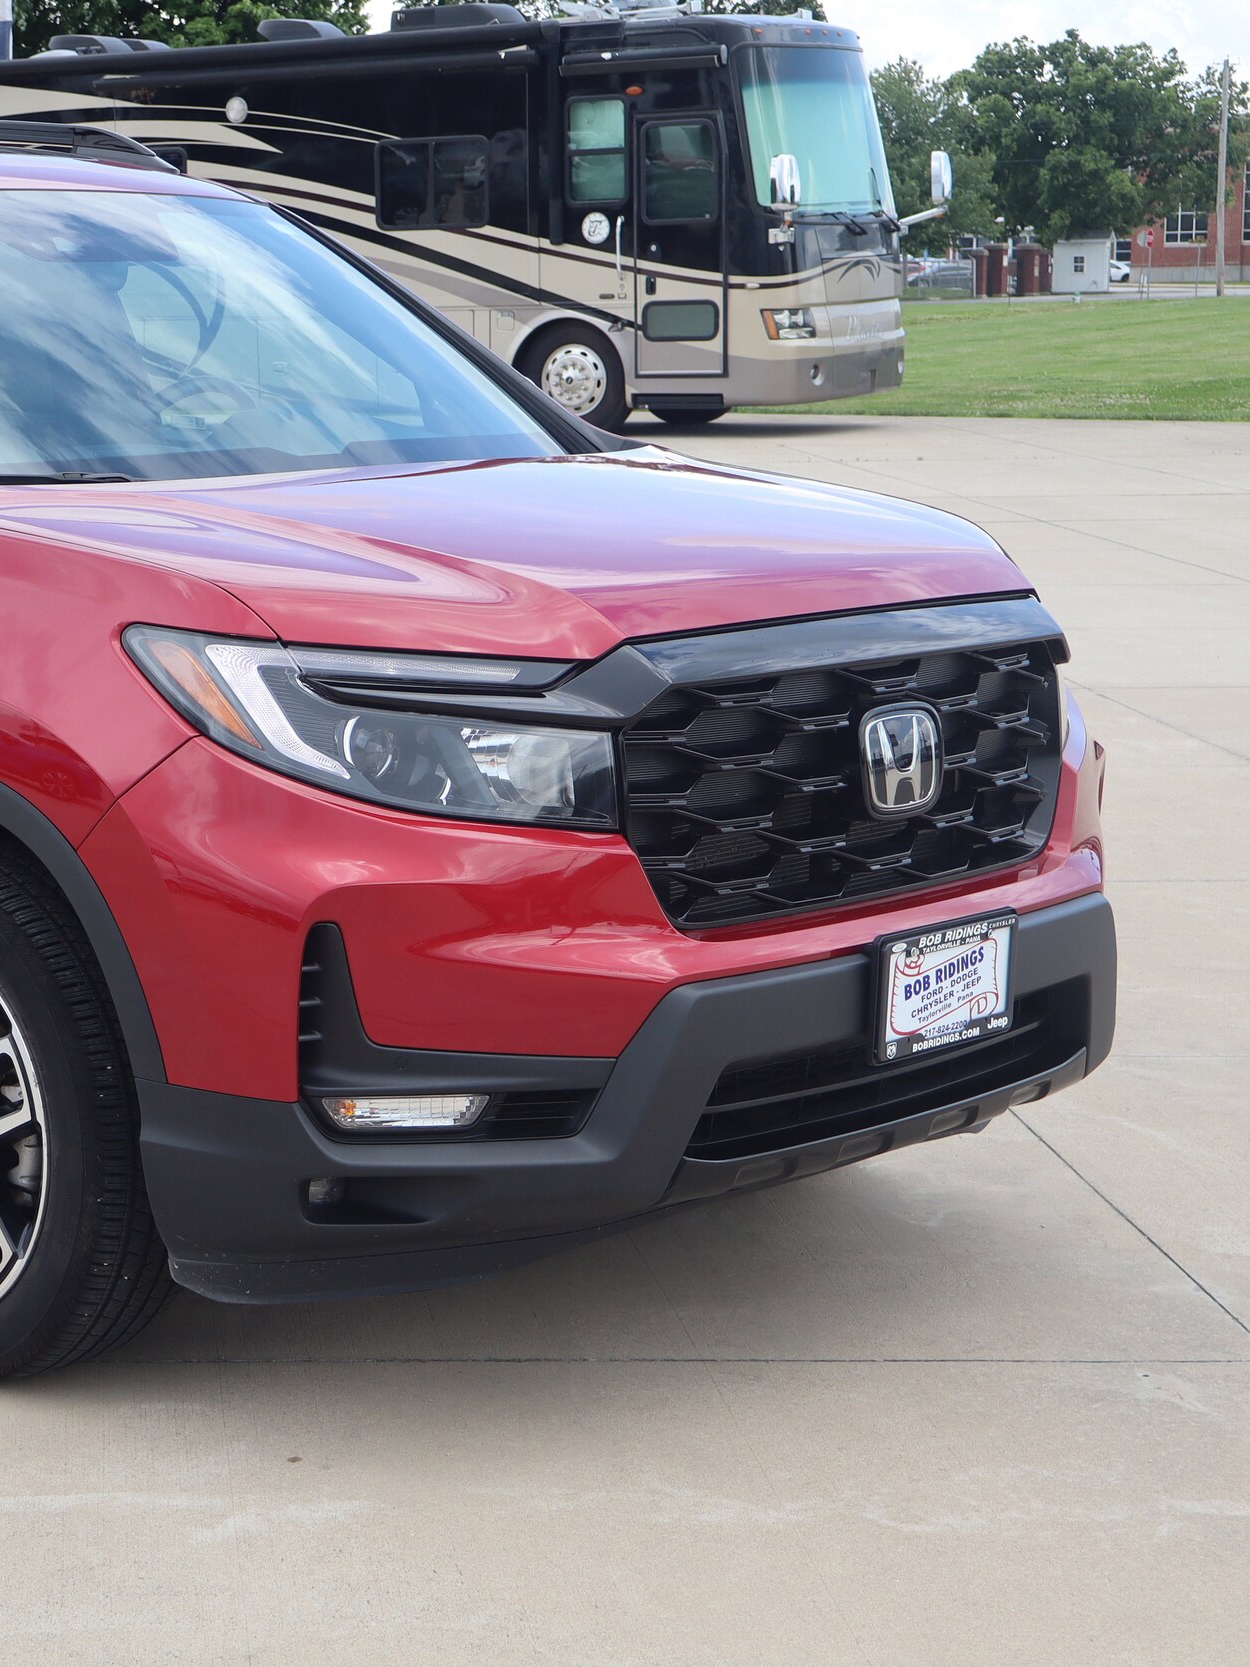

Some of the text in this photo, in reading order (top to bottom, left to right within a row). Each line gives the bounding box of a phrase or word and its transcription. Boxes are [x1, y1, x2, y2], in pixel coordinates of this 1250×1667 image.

[918, 933, 942, 948] BOB
[944, 922, 988, 942] RIDINGS
[922, 939, 961, 954] TAYLORVILLE
[965, 935, 981, 945] PANA
[904, 946, 984, 1001] BOB RIDINGS
[921, 985, 944, 1003] FORD
[950, 967, 979, 988] DODGE
[911, 990, 955, 1018] CHRYSLER
[961, 976, 982, 992] JEEP
[918, 991, 974, 1024] Taylorville Pana
[924, 1019, 967, 1037] 217-824-2200
[987, 1016, 1008, 1029] Jeep
[912, 1027, 980, 1052] BOBRIDINGS.COM
